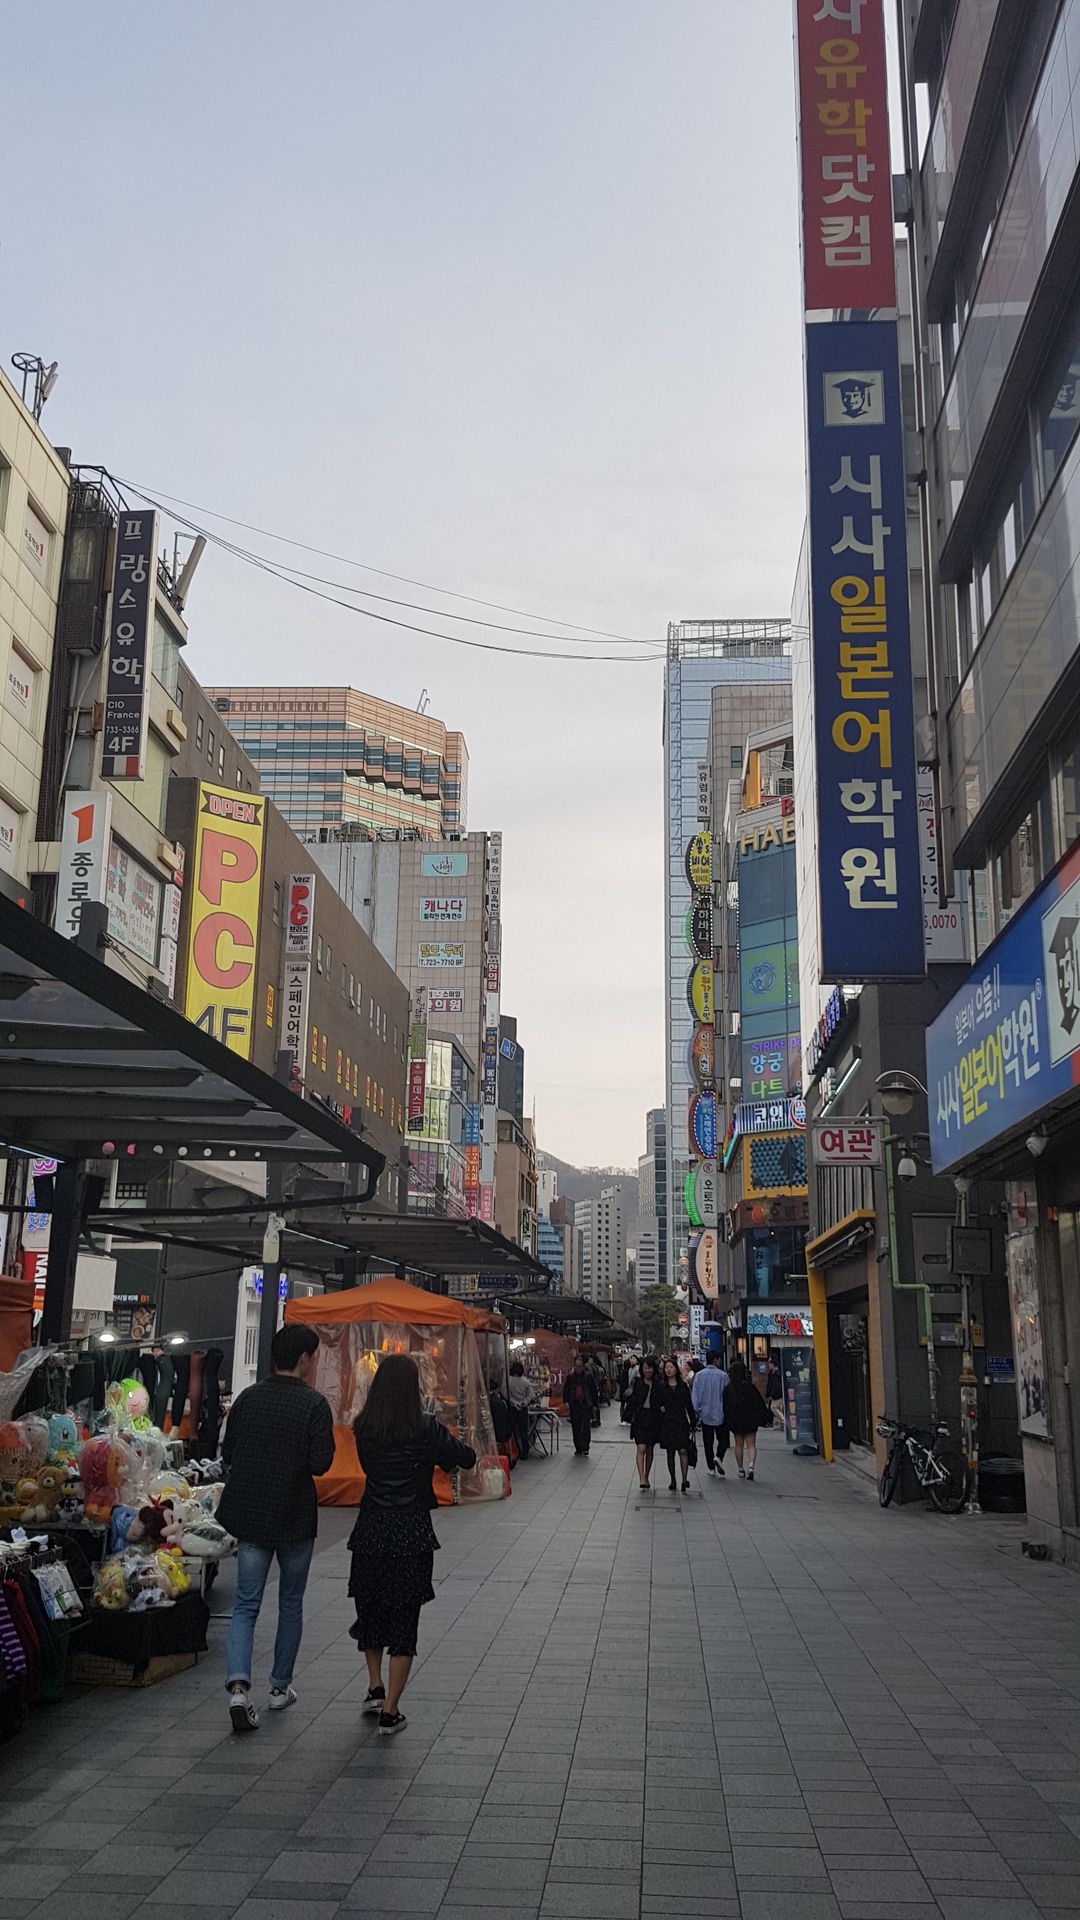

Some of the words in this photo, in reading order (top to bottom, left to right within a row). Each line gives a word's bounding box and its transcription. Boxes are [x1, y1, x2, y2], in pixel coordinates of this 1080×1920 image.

[112, 520, 149, 685] 프랑스유학
[829, 455, 903, 909] 시사일본어학원
[107, 701, 125, 709] CIO
[108, 737, 134, 752] 4F
[209, 795, 256, 823] OPEN
[193, 828, 258, 990] PC
[290, 885, 309, 926] PC
[424, 900, 463, 912] 캐나다
[955, 1011, 975, 1047] 일본어
[752, 1040, 786, 1053] STRIKE
[751, 1052, 783, 1074] 양궁
[937, 992, 1041, 1138] 시사일본어학원
[752, 1079, 785, 1099] 다트
[754, 1105, 783, 1123] 코인
[820, 1129, 875, 1154] 여관
[34, 1254, 48, 1290] NAIL
